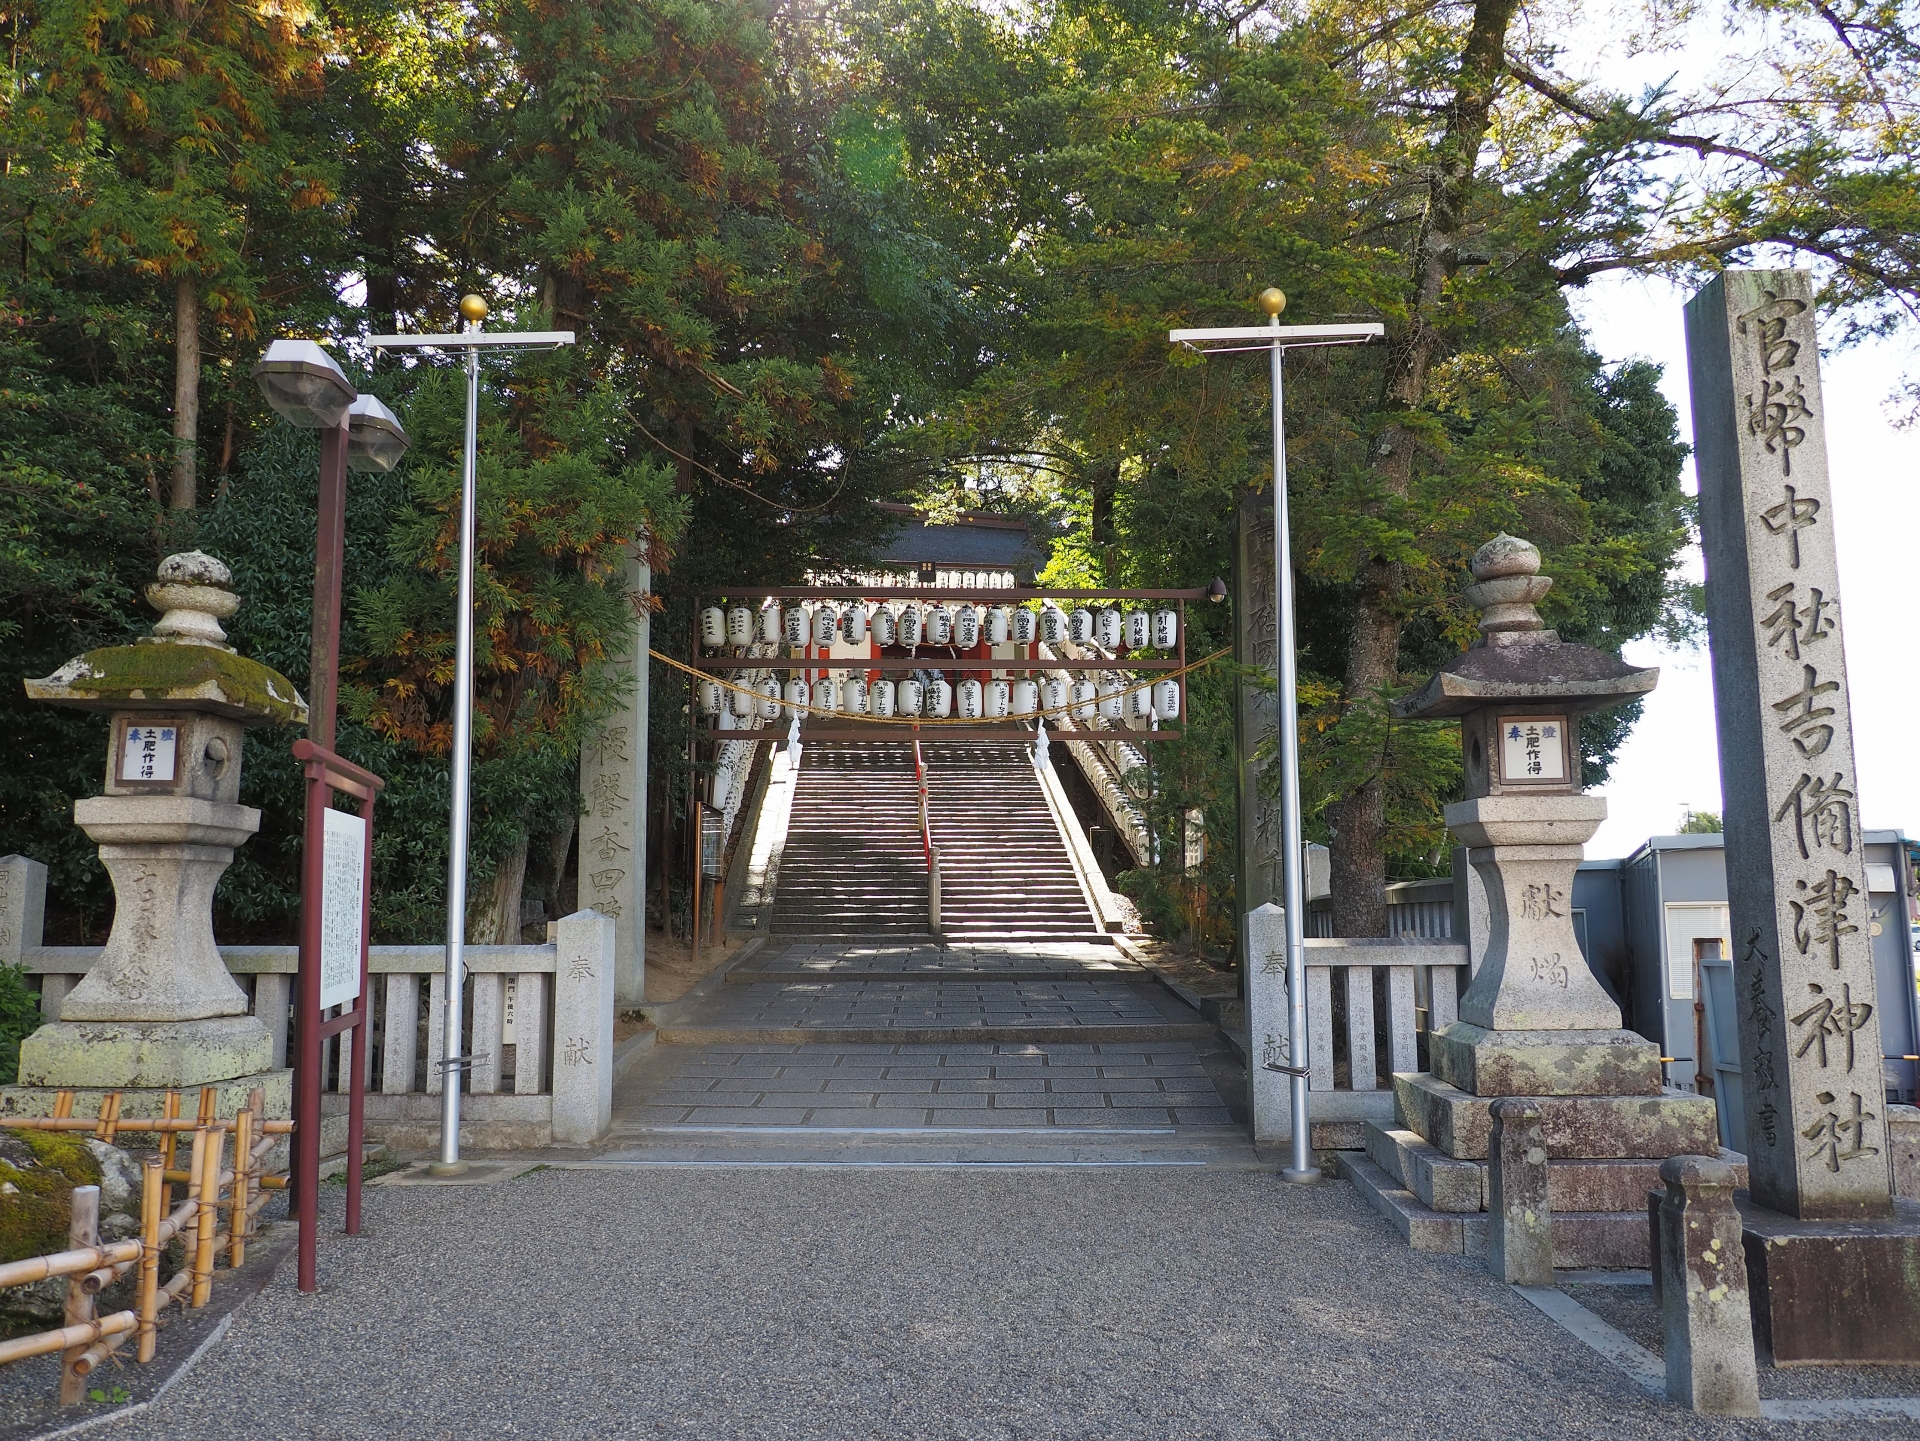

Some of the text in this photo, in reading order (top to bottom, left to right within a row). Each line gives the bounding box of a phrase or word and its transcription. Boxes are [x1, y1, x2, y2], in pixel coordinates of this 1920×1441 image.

[1133, 617, 1144, 646] 引地組
[1157, 616, 1169, 644] 引地組
[128, 728, 142, 744] 奉
[1508, 726, 1525, 742] 奉
[141, 729, 157, 779] 土肥作得
[1526, 726, 1543, 775] 土肥作得
[506, 996, 514, 1025] 午後六時
